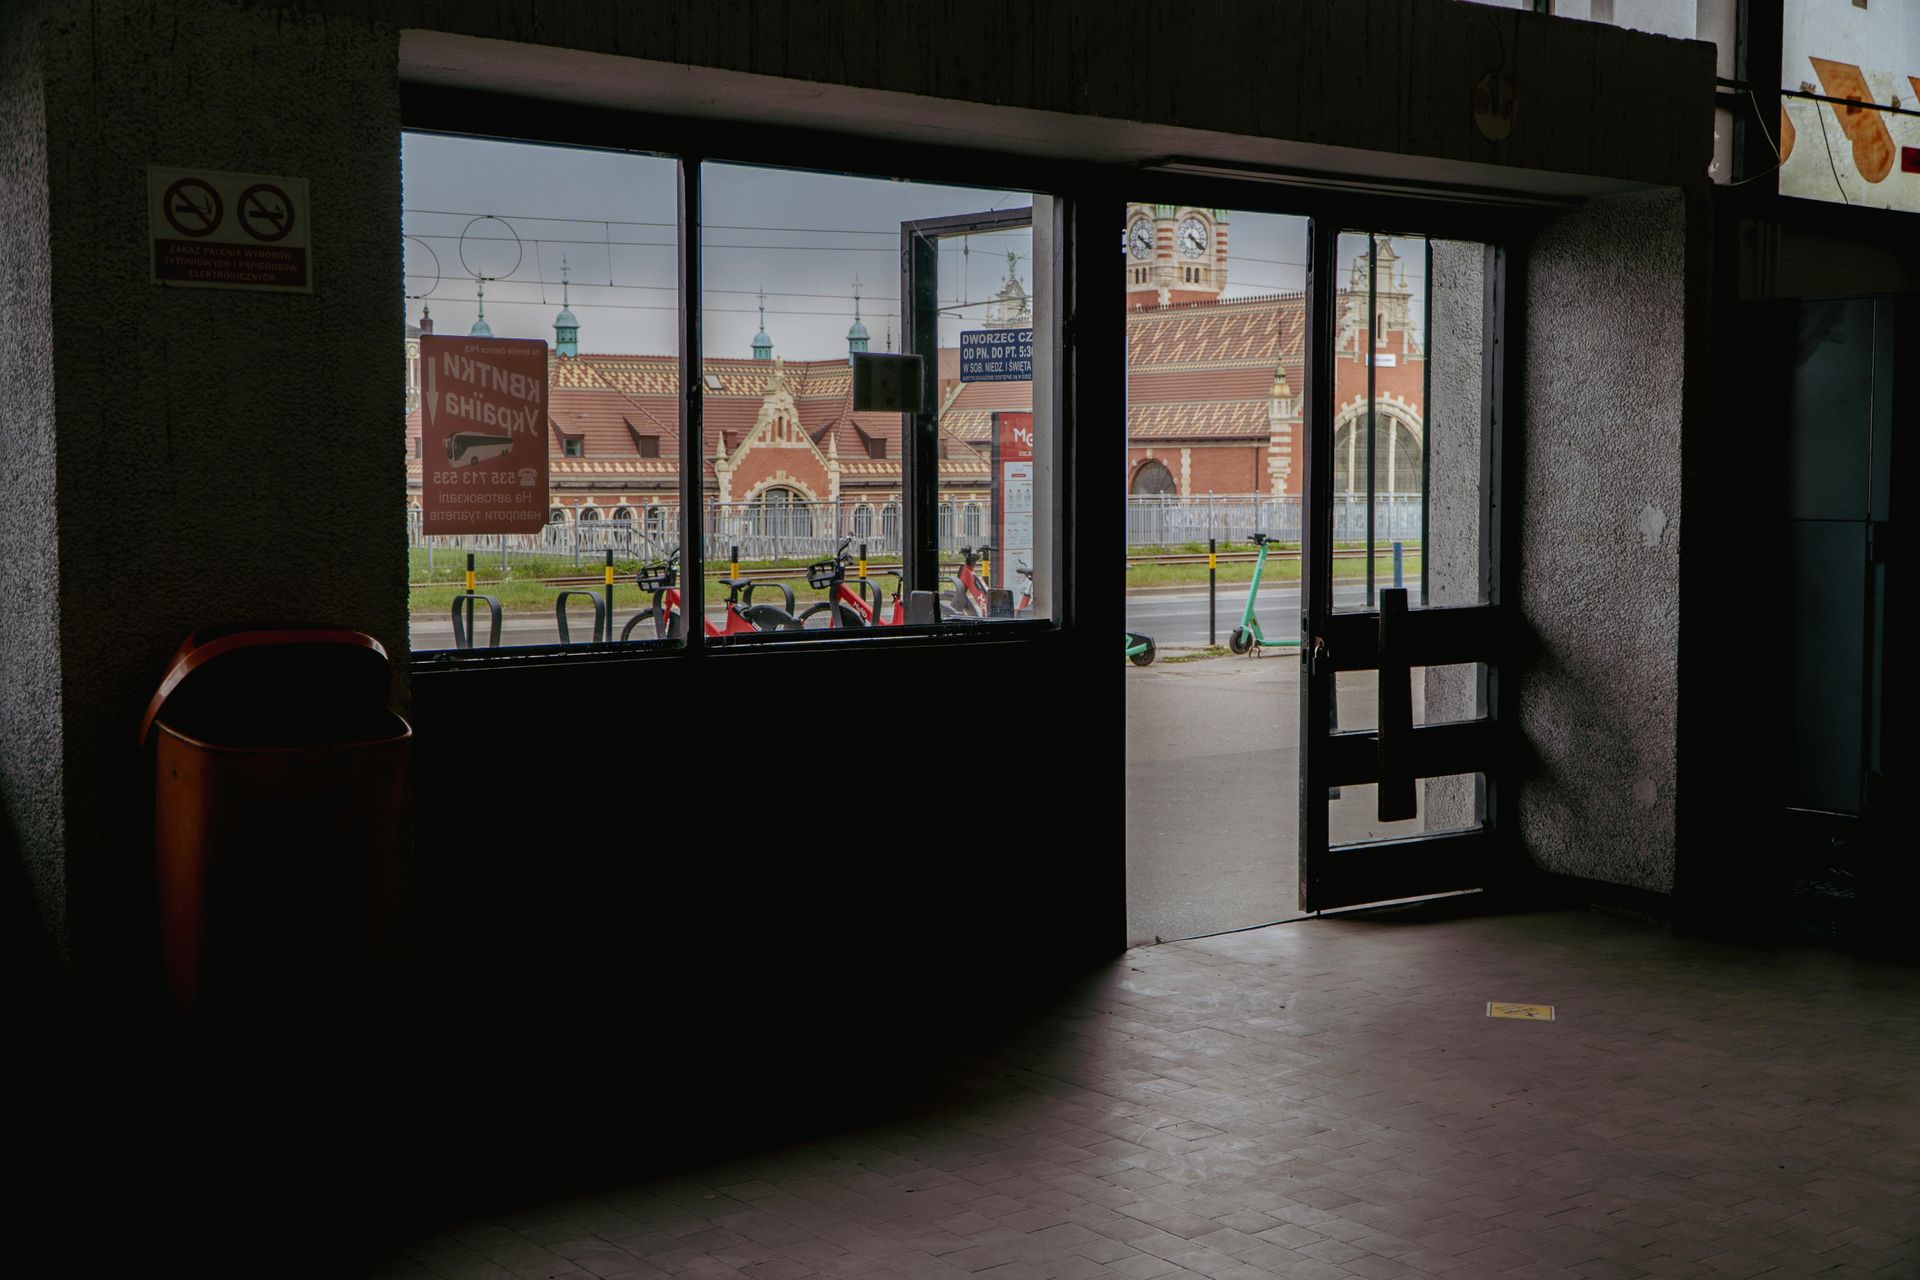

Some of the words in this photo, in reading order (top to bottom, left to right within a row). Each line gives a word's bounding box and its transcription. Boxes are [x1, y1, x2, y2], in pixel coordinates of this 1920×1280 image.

[169, 245, 201, 255] ZAKAZ
[203, 247, 241, 257] PALENIA
[188, 271, 276, 282] ELEKTRONICZNYCH
[962, 333, 1015, 345] DWORZEC
[963, 348, 974, 360] OD
[976, 347, 990, 359] PN.
[991, 346, 1003, 358] DO
[1005, 346, 1017, 358] PT.
[1019, 345, 1033, 358] 5:3
